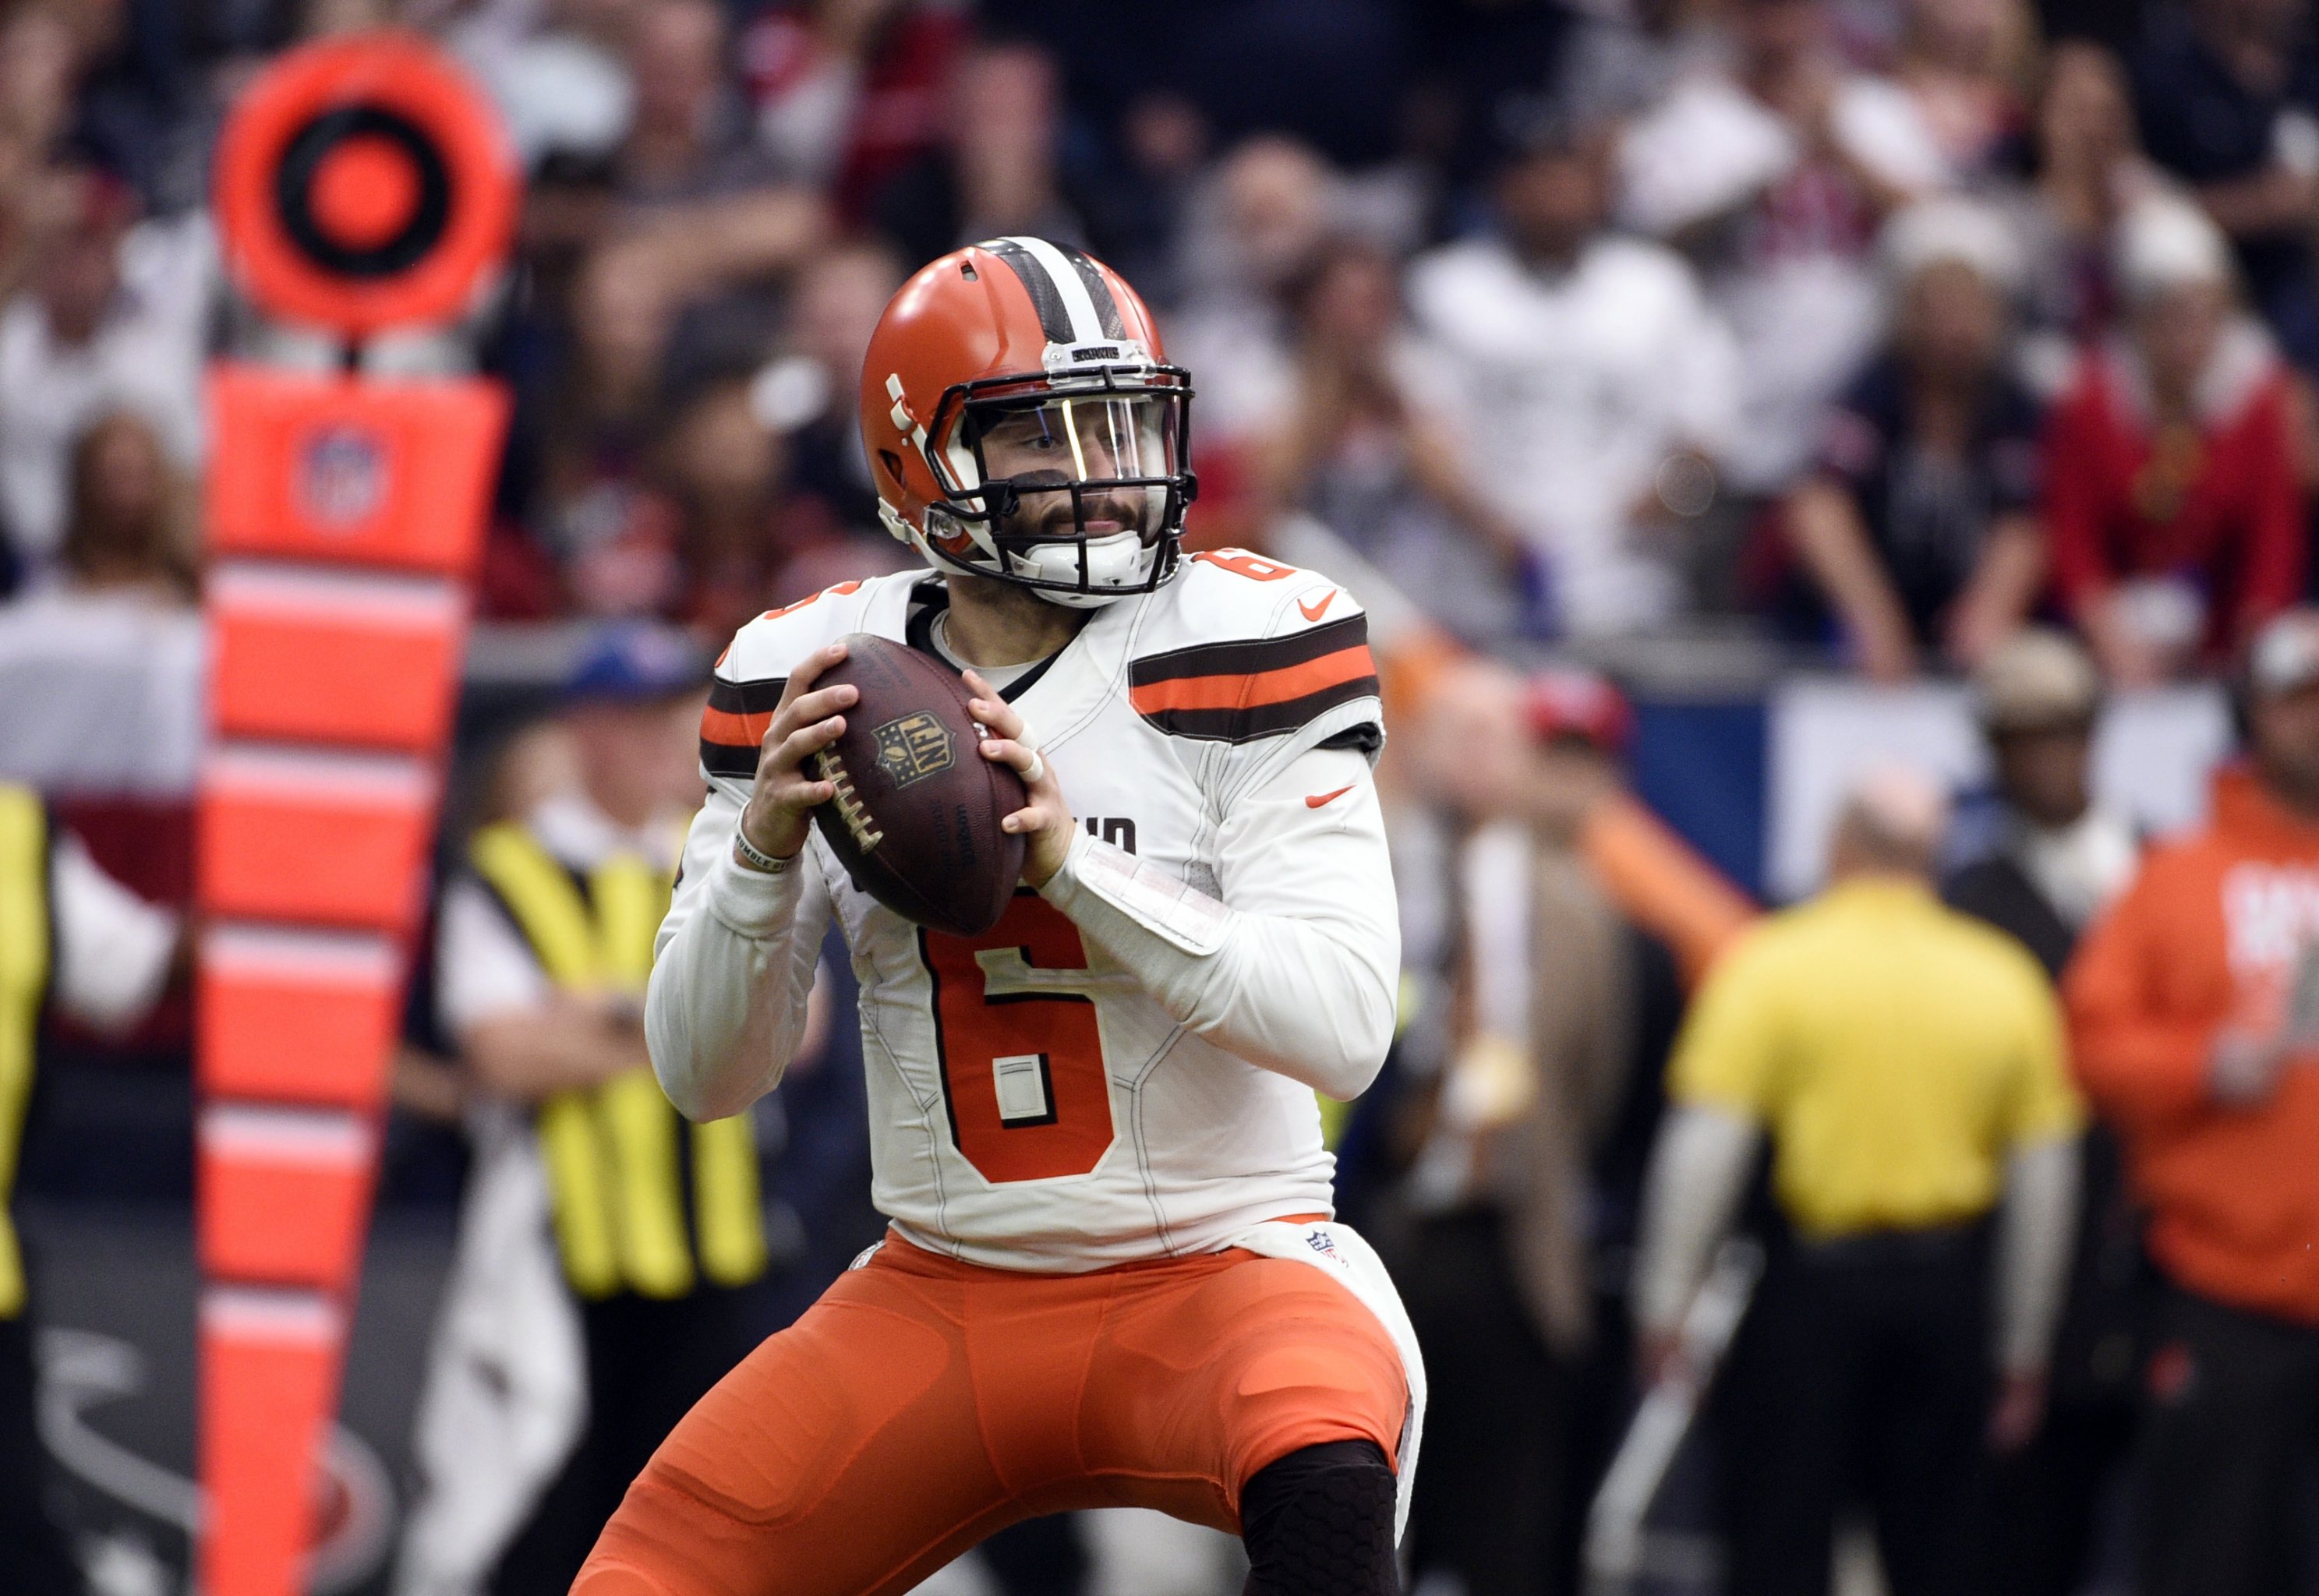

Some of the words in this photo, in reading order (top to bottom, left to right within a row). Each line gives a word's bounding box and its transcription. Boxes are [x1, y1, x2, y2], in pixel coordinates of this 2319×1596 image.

[1072, 347, 1120, 362] BROWNS
[901, 715, 949, 773] NFL
[735, 832, 771, 867] HUMBLE
[918, 886, 1116, 1184] 6
